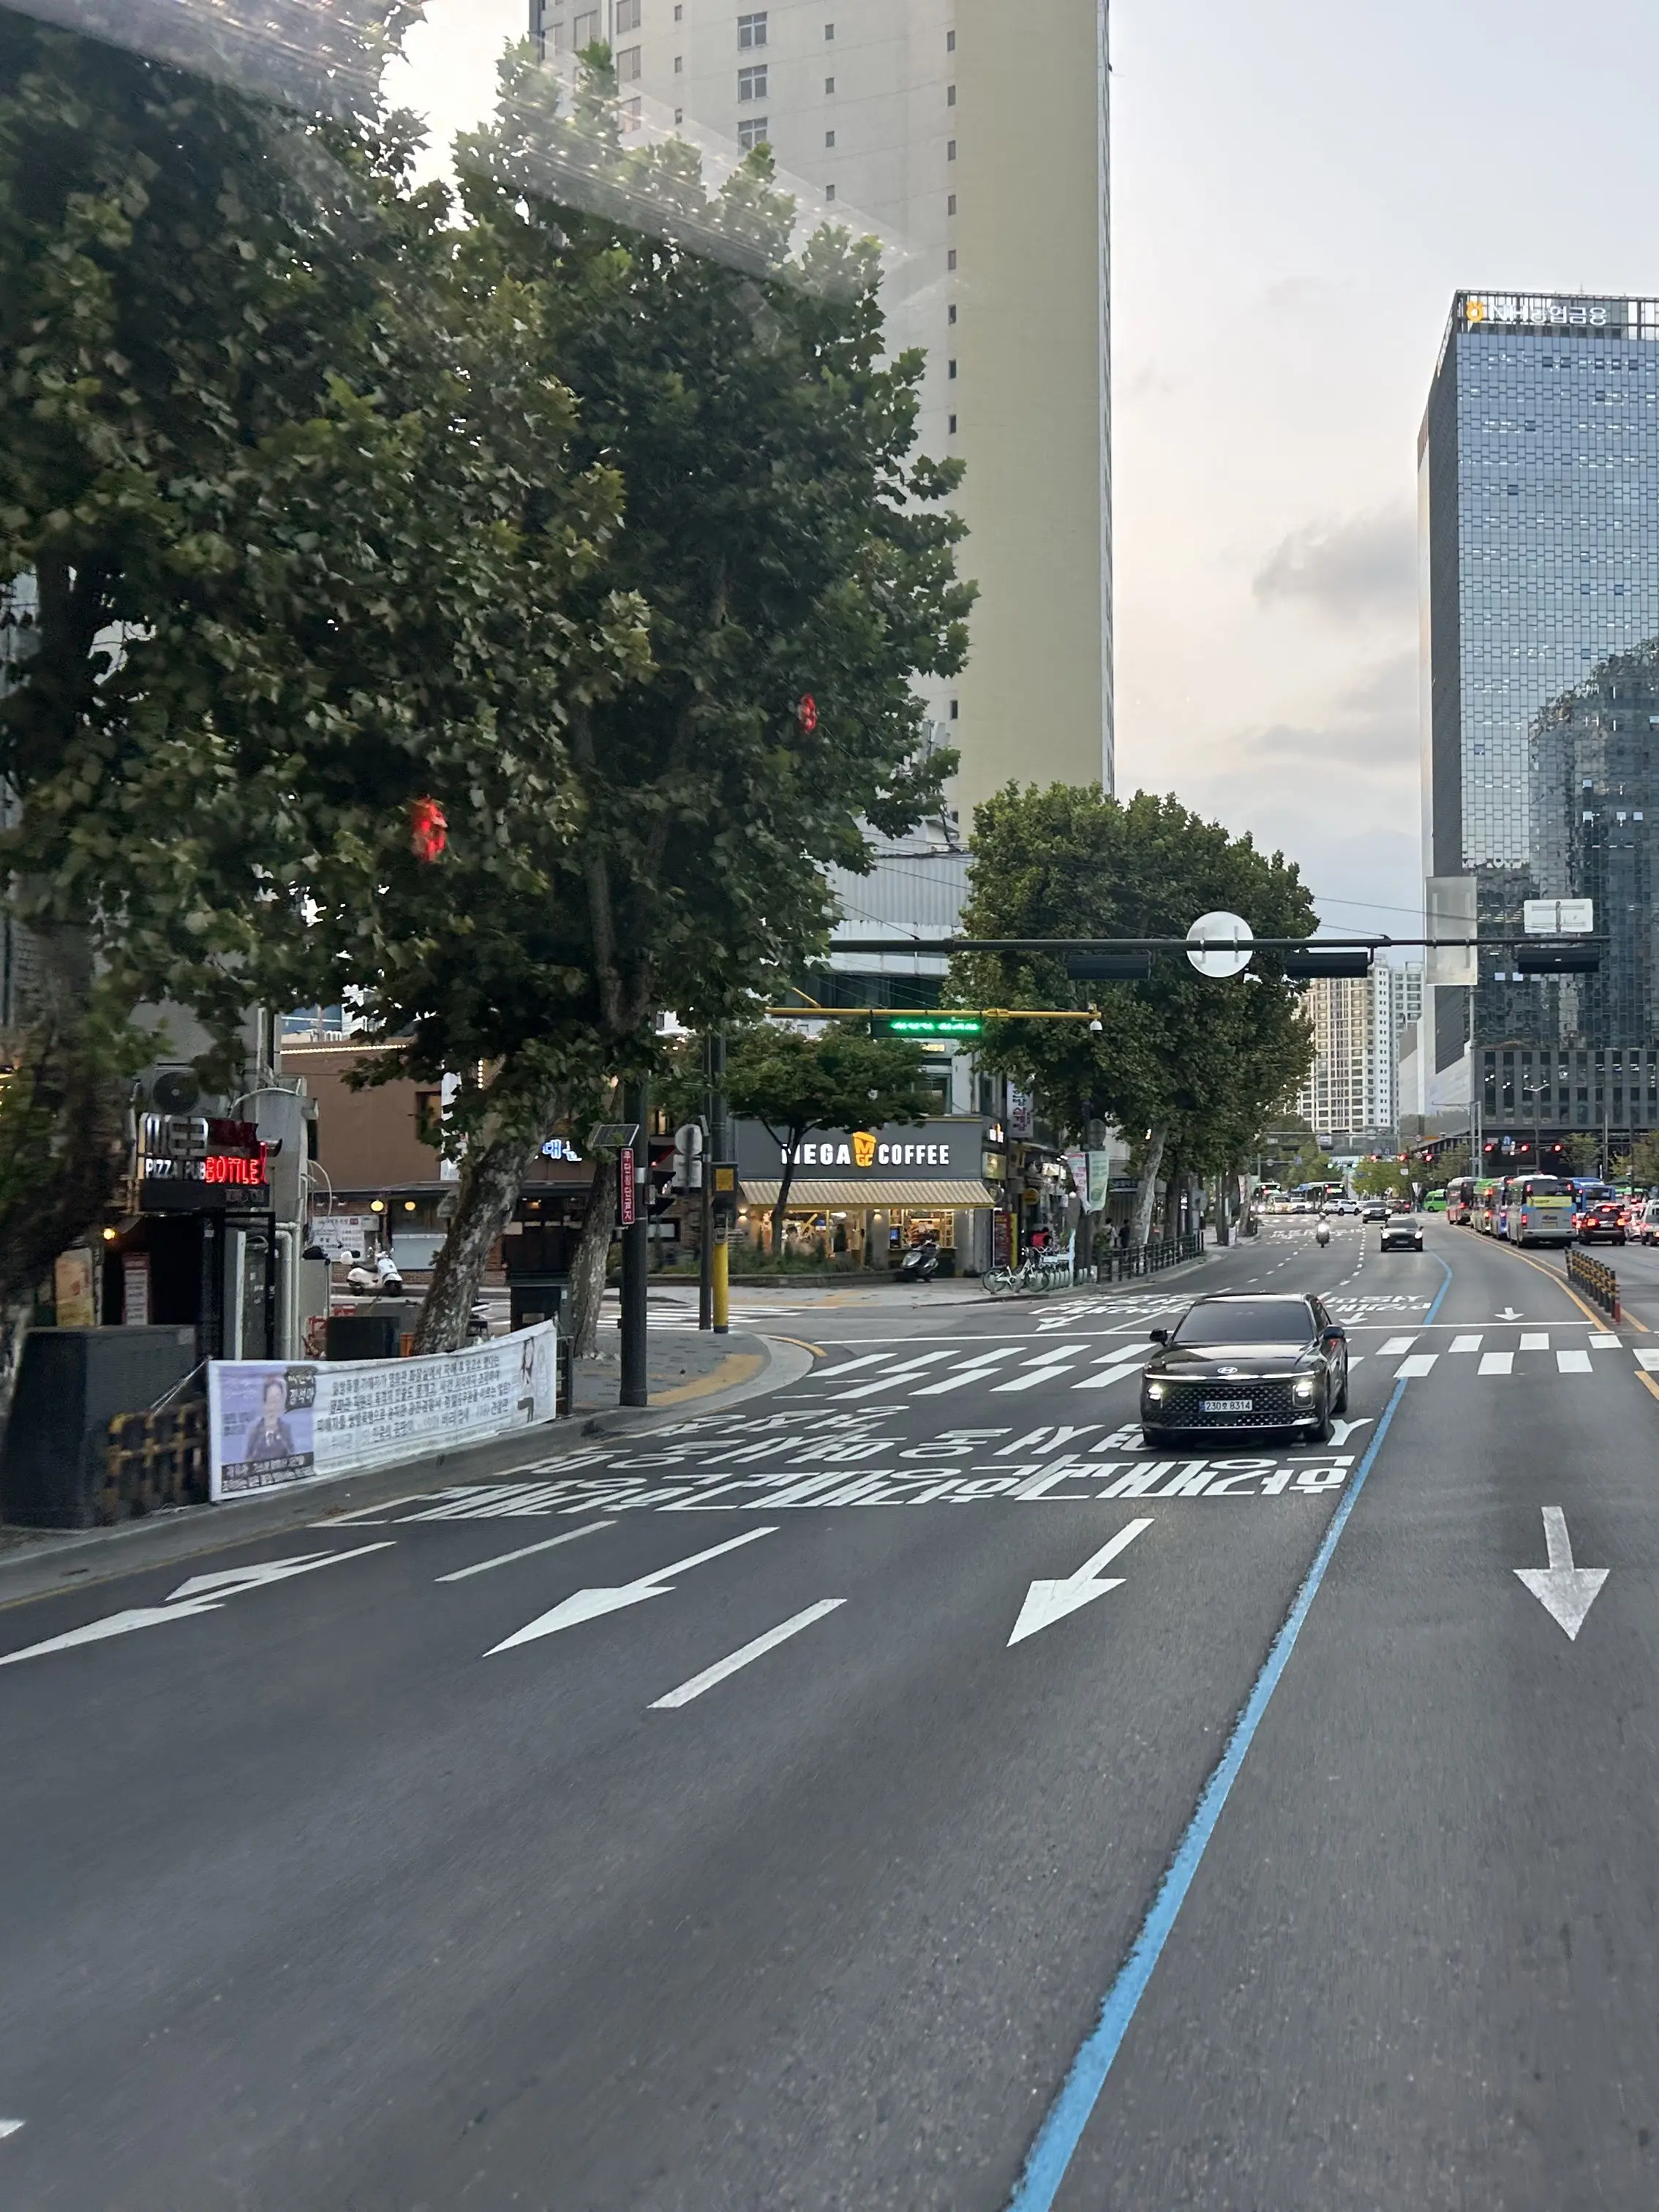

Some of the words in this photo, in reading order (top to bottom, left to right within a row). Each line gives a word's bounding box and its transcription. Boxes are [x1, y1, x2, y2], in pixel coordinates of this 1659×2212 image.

[1489, 303, 1607, 326] NH농협금융
[146, 1158, 179, 1179] PIZZA
[206, 1156, 261, 1185] BOTTLE
[781, 1143, 851, 1165] MEGA
[879, 1143, 949, 1165] COFFEE
[1230, 1401, 1250, 1410] 8314
[493, 1435, 838, 1475] 서울역
[784, 1424, 1105, 1464] 서울역
[655, 1464, 1043, 1511] 한강대교
[1014, 1456, 1355, 1501] 한강대교
[306, 1473, 733, 1527] 한강대교
